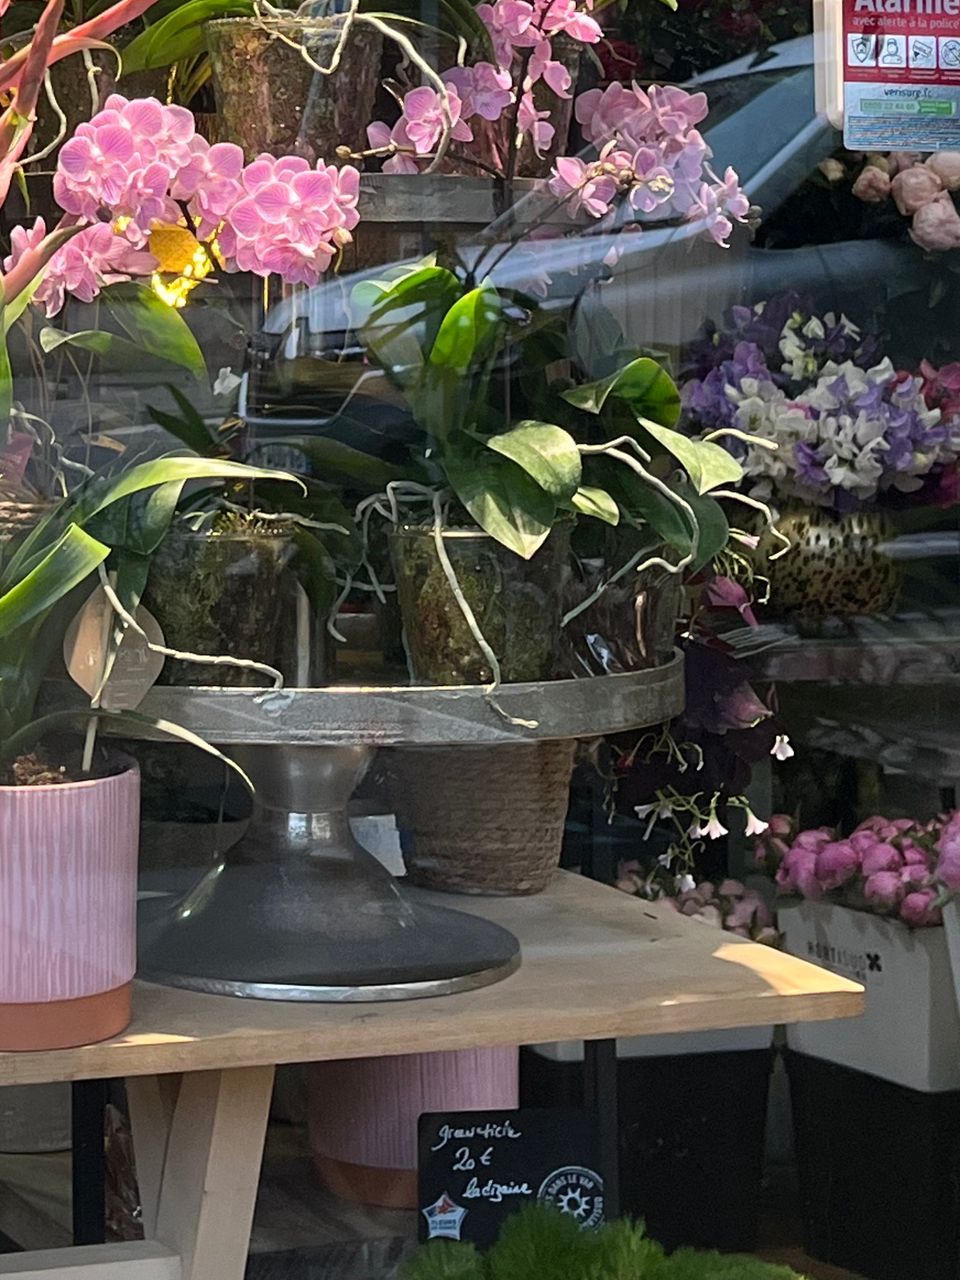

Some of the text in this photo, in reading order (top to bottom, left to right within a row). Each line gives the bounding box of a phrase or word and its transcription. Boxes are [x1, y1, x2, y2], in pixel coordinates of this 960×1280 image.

[852, 17, 876, 26] avec
[877, 16, 907, 27] alerte
[917, 17, 927, 28] la
[930, 18, 959, 30] police
[452, 1147, 493, 1170] 20 €
